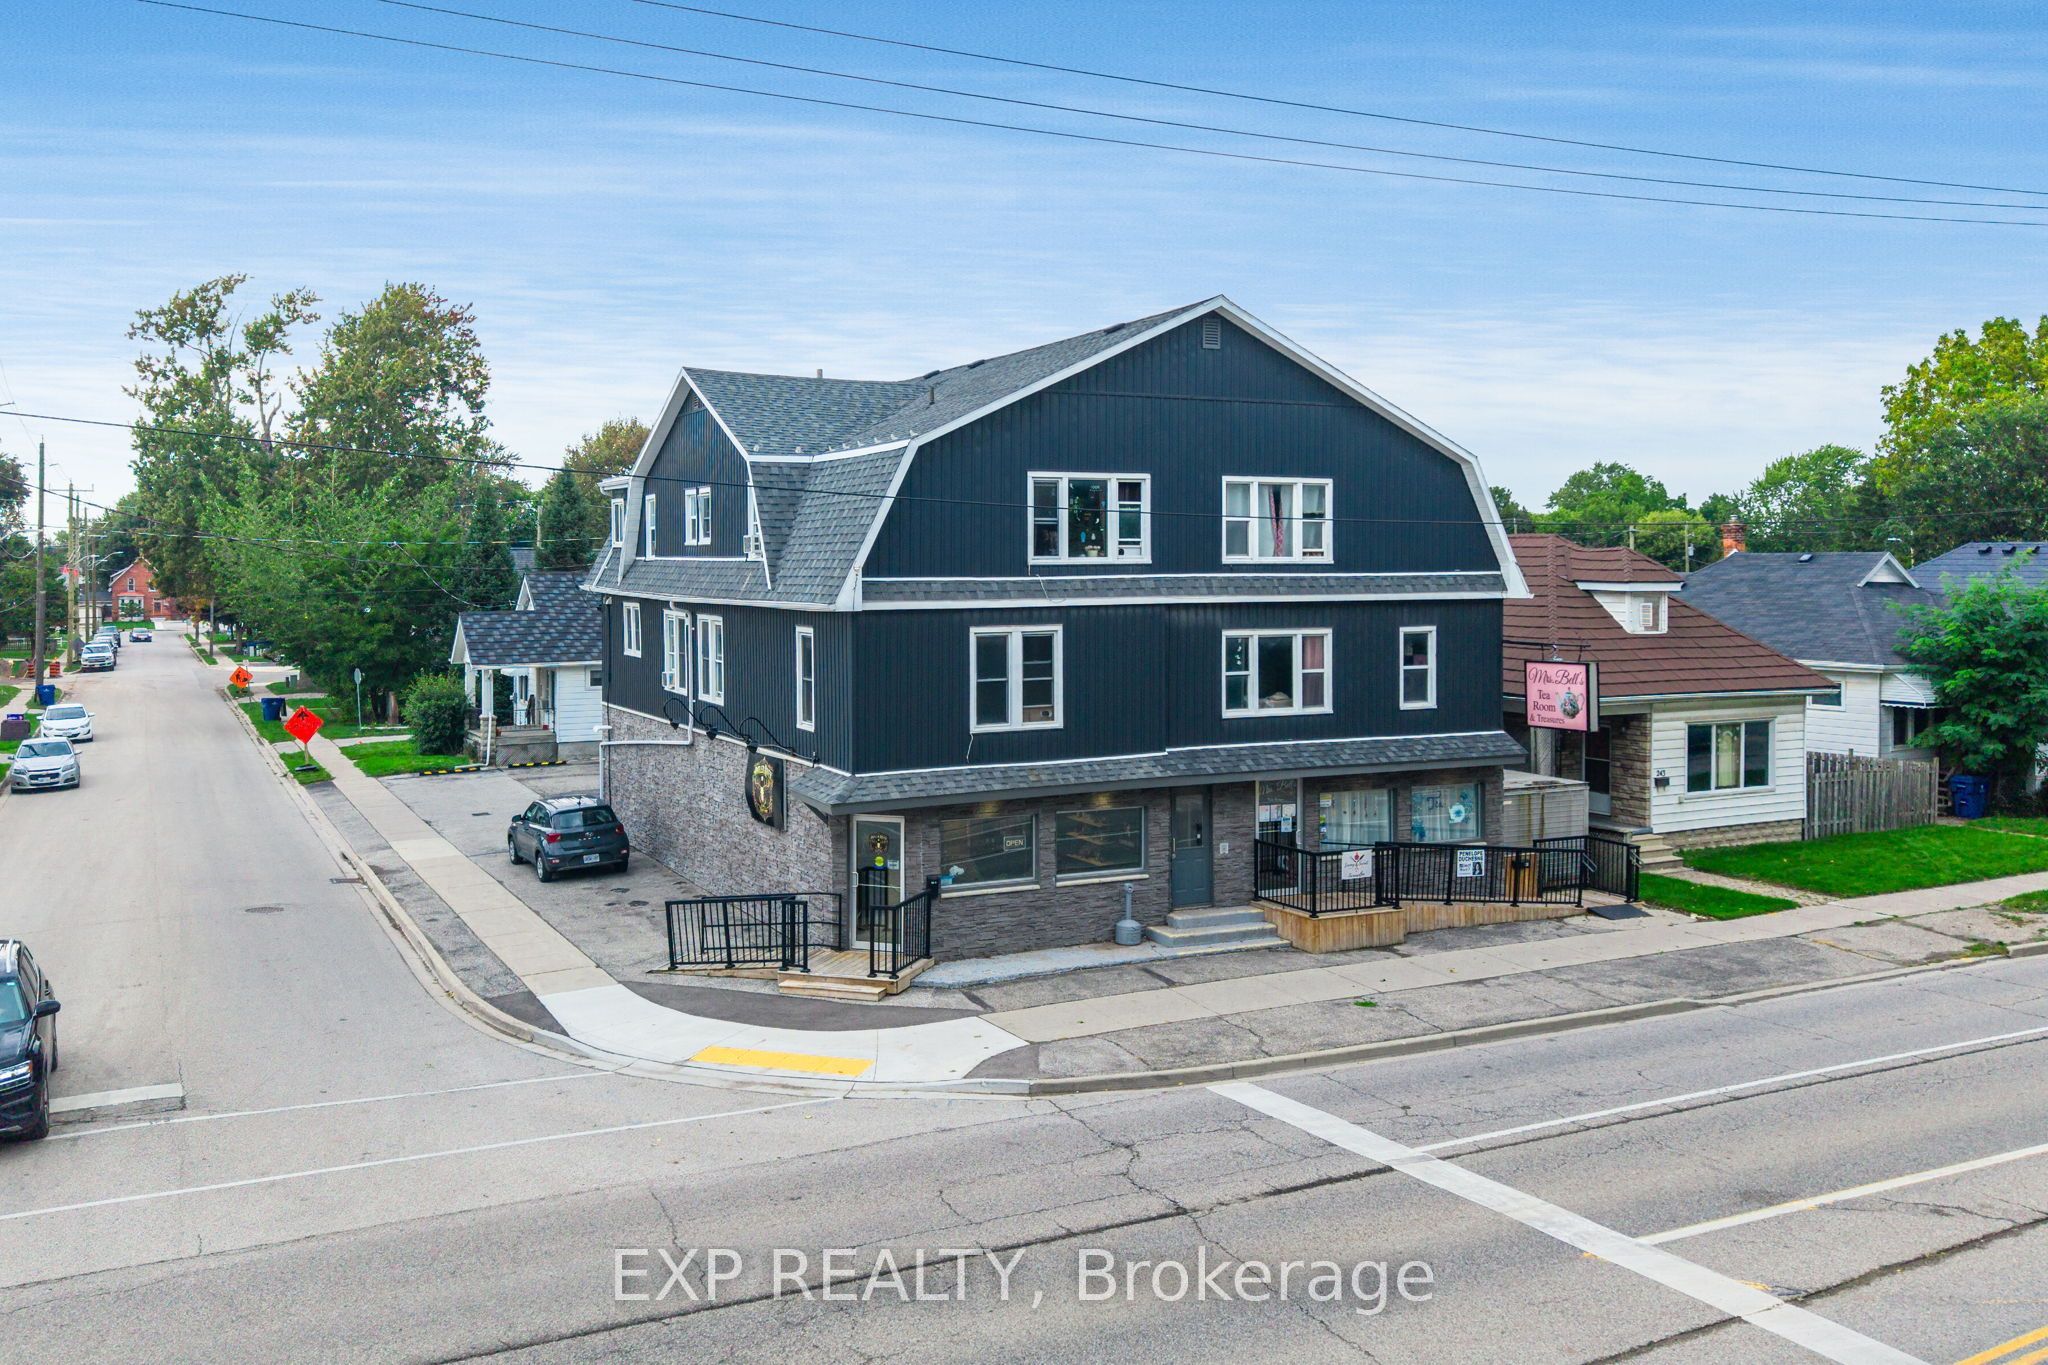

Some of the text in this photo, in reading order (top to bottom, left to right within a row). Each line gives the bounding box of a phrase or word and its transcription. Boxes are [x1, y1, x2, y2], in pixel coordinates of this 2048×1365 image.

[1555, 669, 1584, 686] Bell's
[1538, 690, 1550, 700] Tea
[1533, 700, 1556, 712] Room
[1537, 714, 1565, 724] Treasures
[1005, 839, 1024, 847] OPEN
